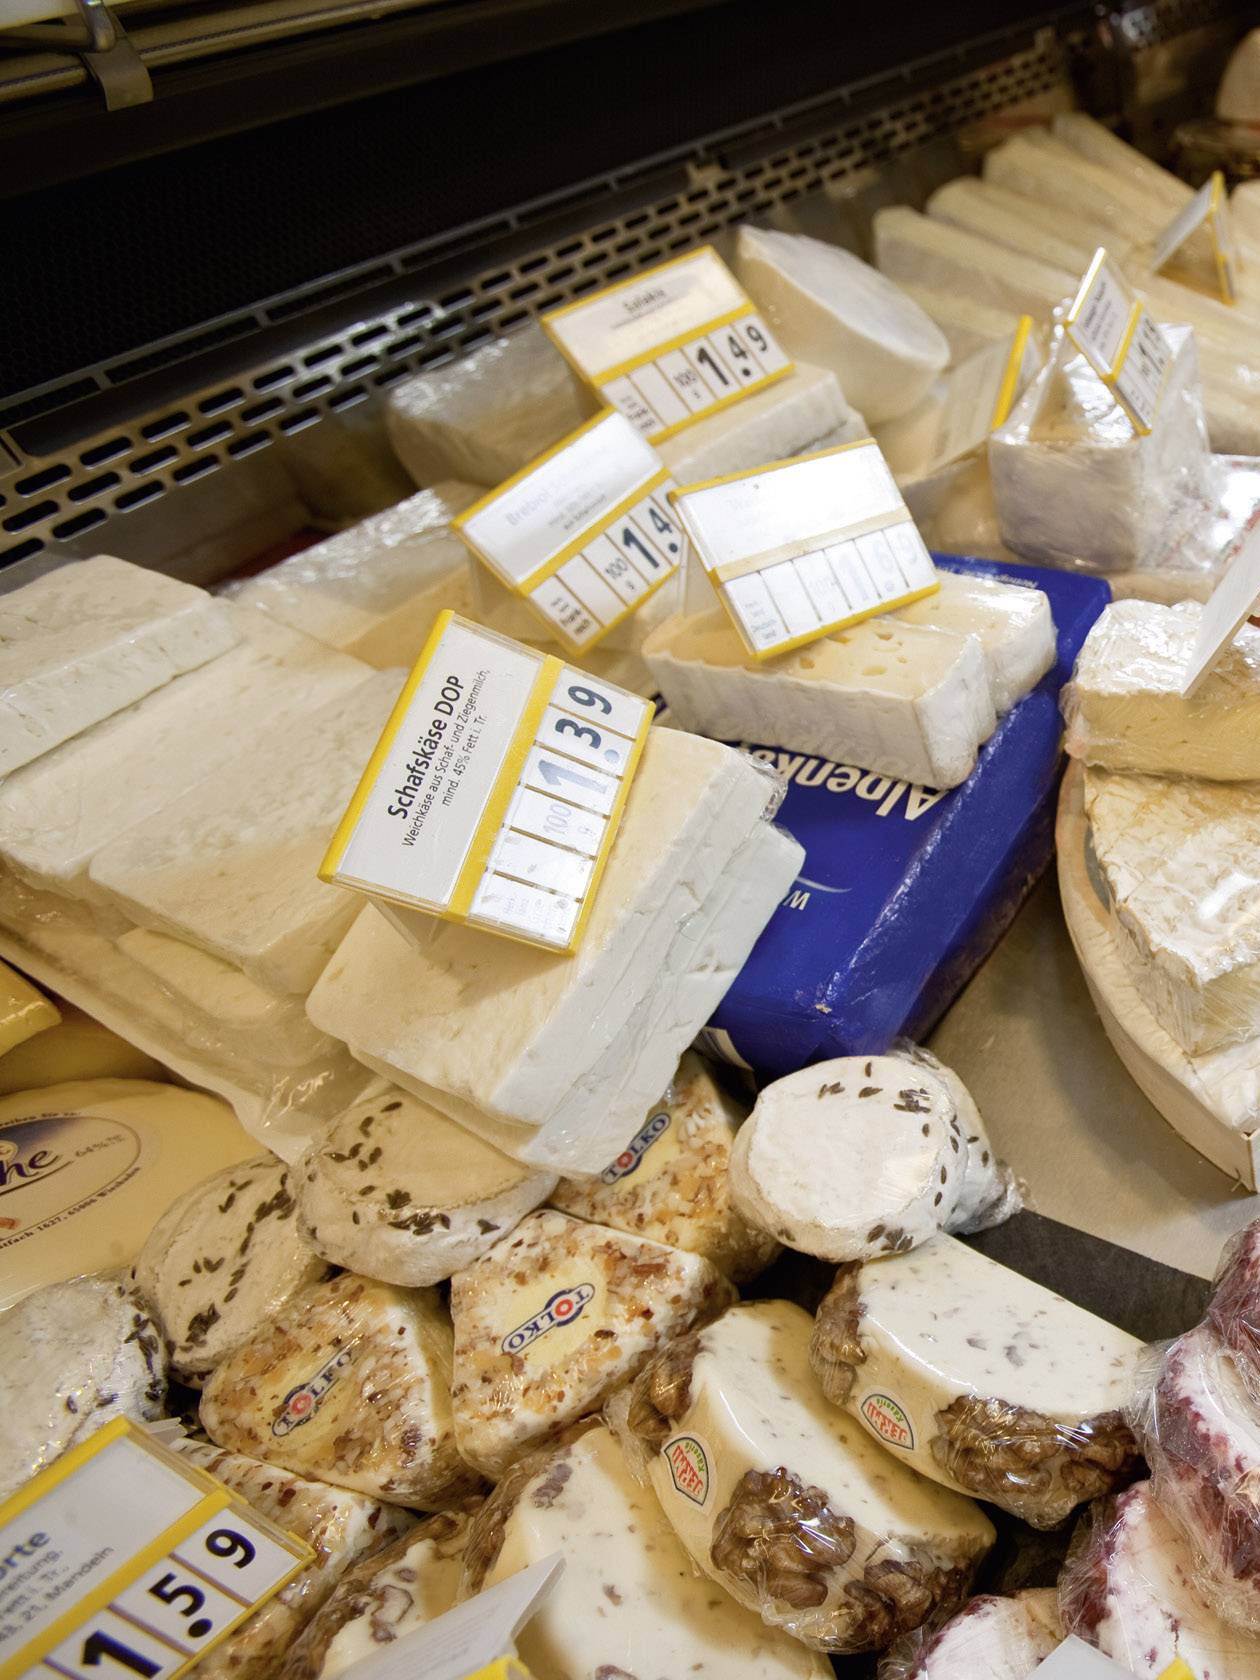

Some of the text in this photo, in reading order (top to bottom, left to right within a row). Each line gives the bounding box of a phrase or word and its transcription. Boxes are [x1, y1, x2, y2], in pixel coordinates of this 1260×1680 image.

[623, 507, 681, 569] 1.4
[387, 674, 465, 820] Schafskäse DOP
[401, 668, 491, 848] Weichkäse aus Schaf- und Ziegenmilch,
[441, 779, 461, 807] mind.
[452, 753, 471, 778] 45%
[464, 729, 481, 757] Fett
[474, 714, 489, 728] Tr.
[604, 1118, 667, 1178] TOLKO
[508, 1289, 591, 1349] TOLKO
